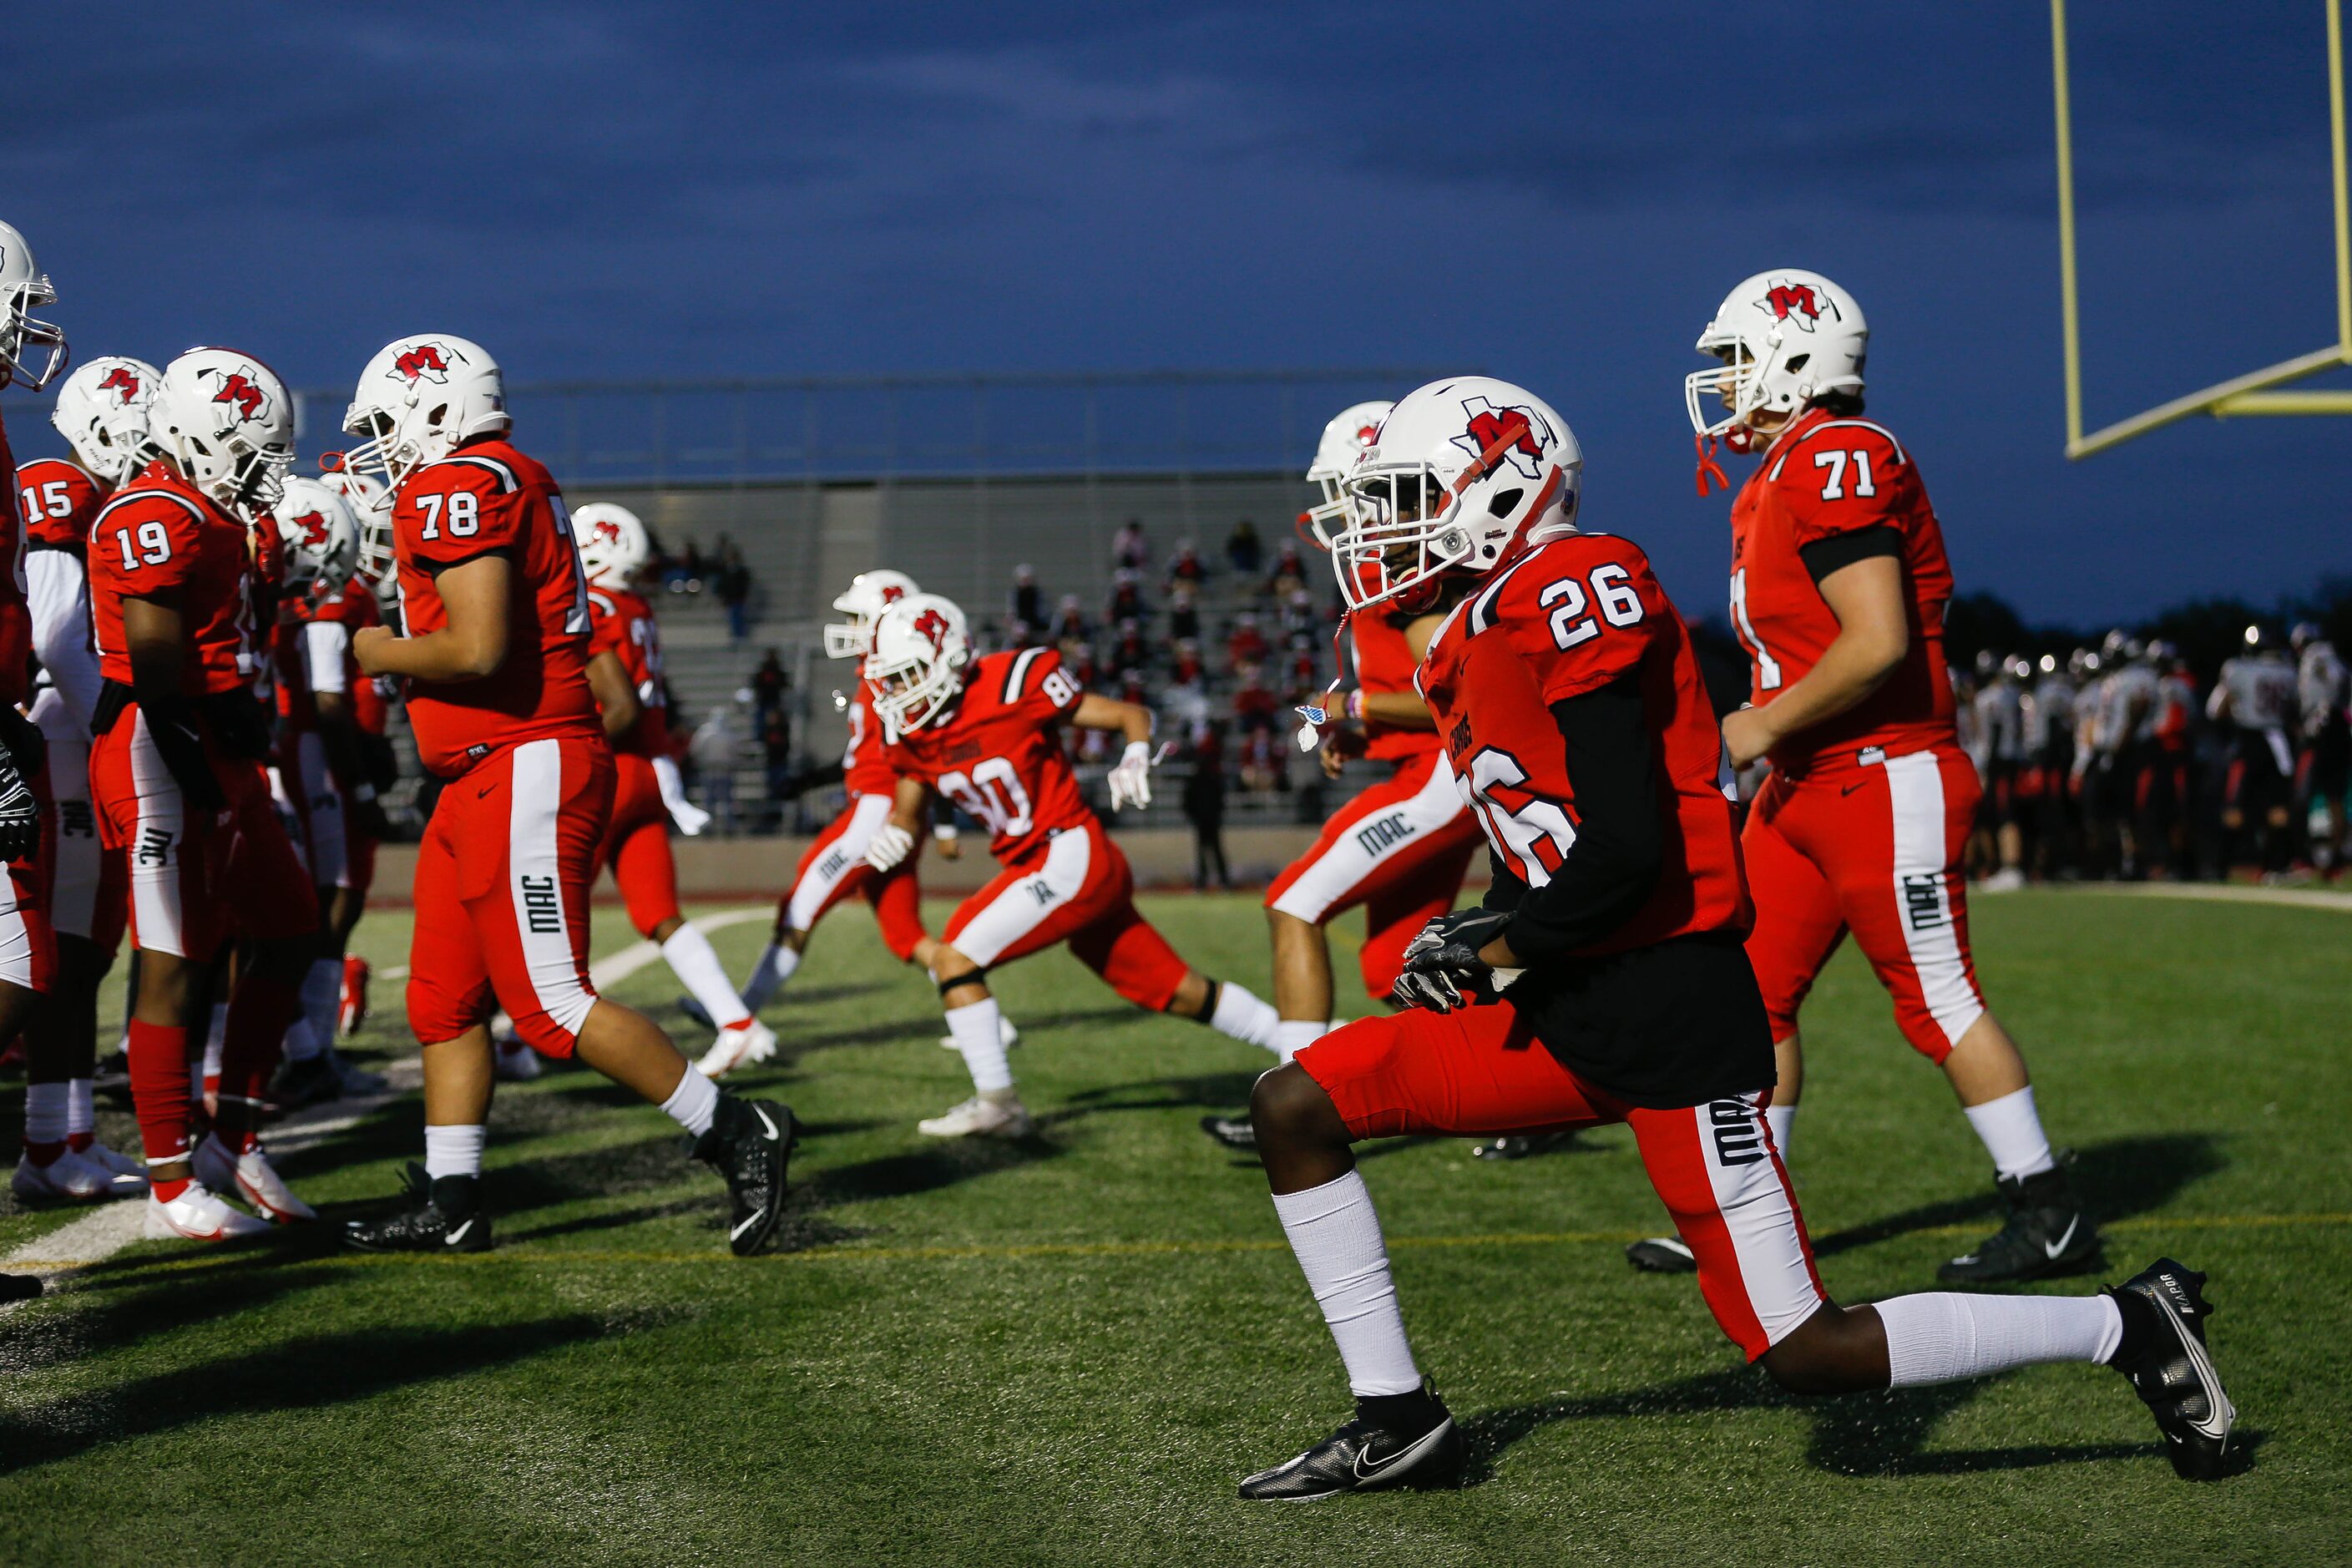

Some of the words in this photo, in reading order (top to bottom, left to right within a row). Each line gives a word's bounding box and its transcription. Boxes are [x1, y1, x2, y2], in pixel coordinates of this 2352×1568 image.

[1766, 285, 1819, 322] M
[1813, 448, 1877, 501] 71
[22, 480, 74, 524] 15
[416, 491, 480, 540] 78
[116, 519, 172, 571] 19
[1536, 561, 1649, 655] 26
[1358, 812, 1415, 857] MAC
[521, 875, 561, 933] MAC
[1903, 874, 1946, 930] MAC
